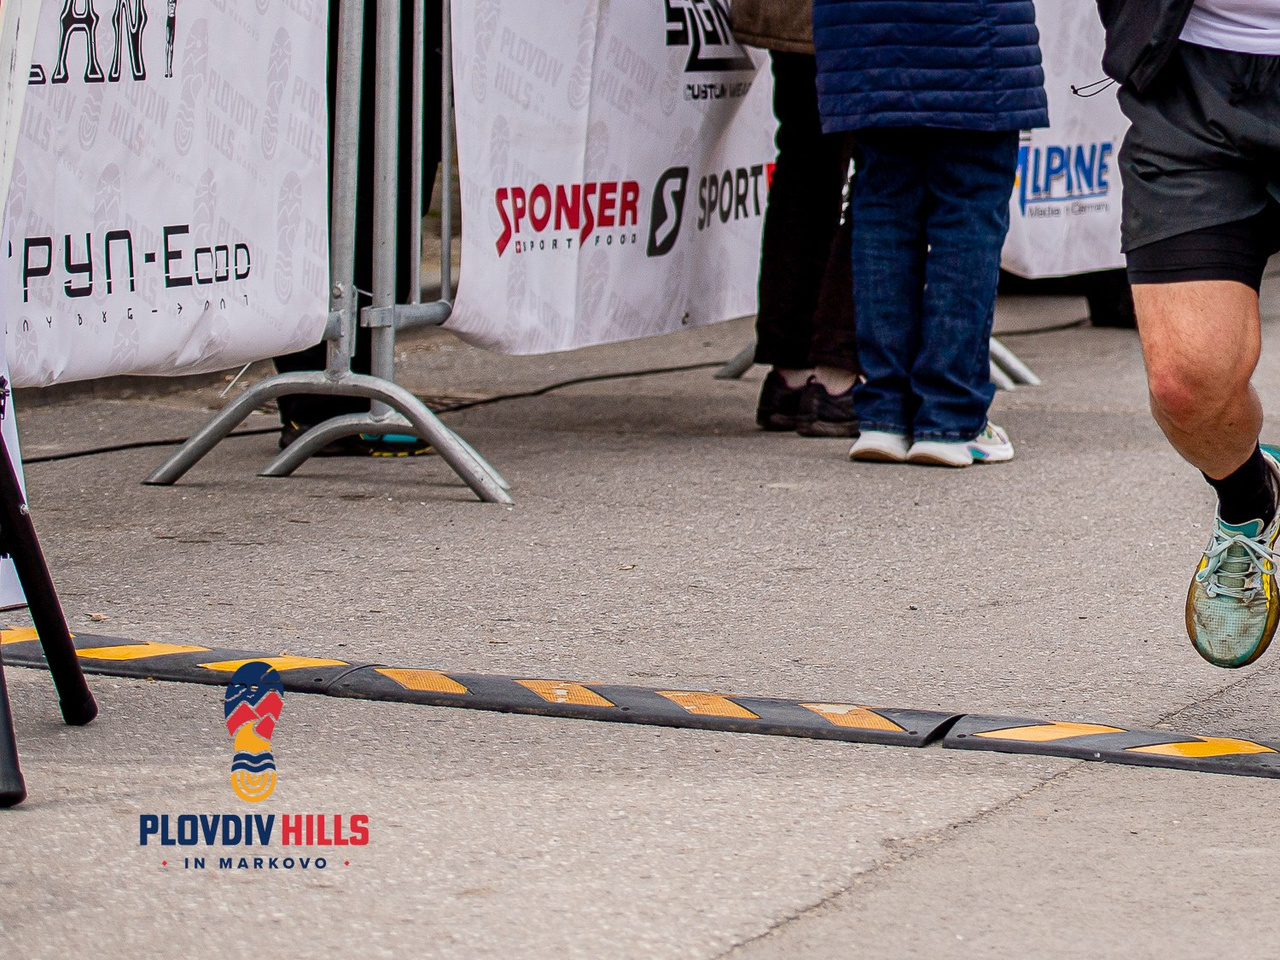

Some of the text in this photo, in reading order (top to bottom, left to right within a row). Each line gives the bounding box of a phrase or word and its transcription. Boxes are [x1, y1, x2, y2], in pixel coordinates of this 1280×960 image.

[495, 179, 641, 259] SPONSER
[698, 164, 764, 232] SPORT
[522, 233, 637, 253] SPORT FOOD
